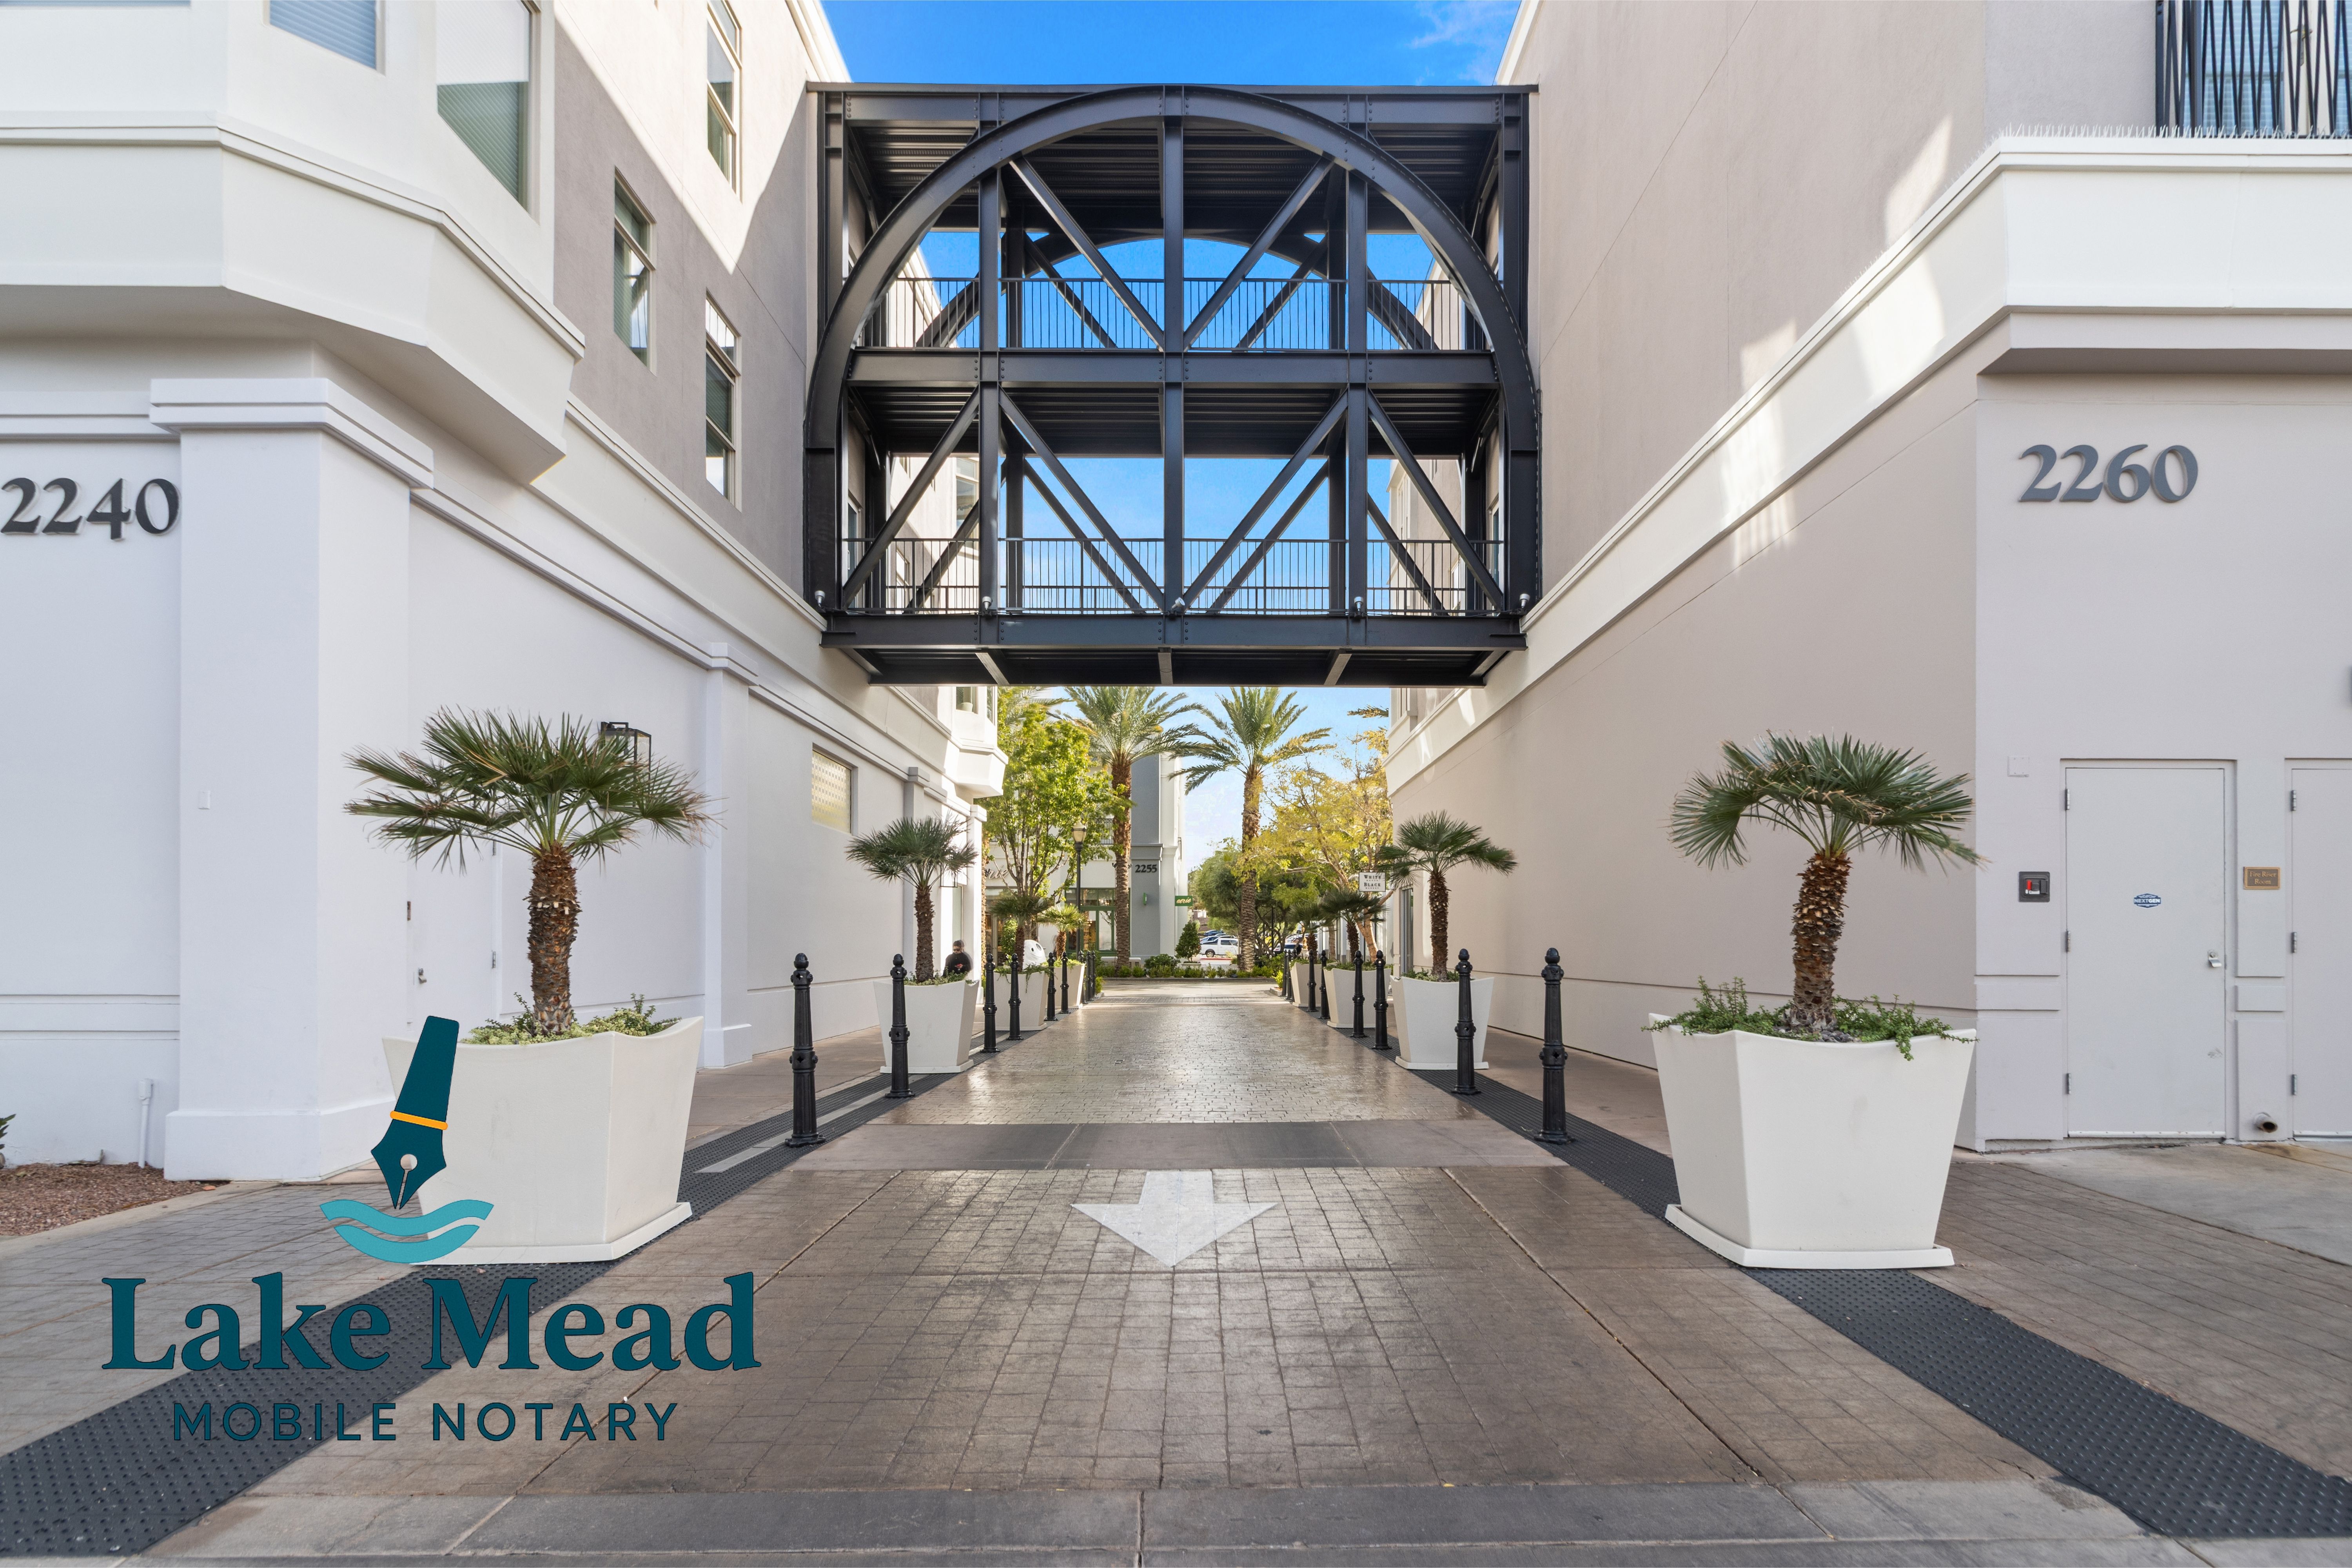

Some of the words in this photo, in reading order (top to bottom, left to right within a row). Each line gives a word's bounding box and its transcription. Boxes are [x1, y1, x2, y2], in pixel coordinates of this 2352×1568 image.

[2018, 444, 2198, 503] 2260
[0, 477, 180, 541] 2240
[988, 865, 1009, 880] rie
[1135, 864, 1157, 873] 2255
